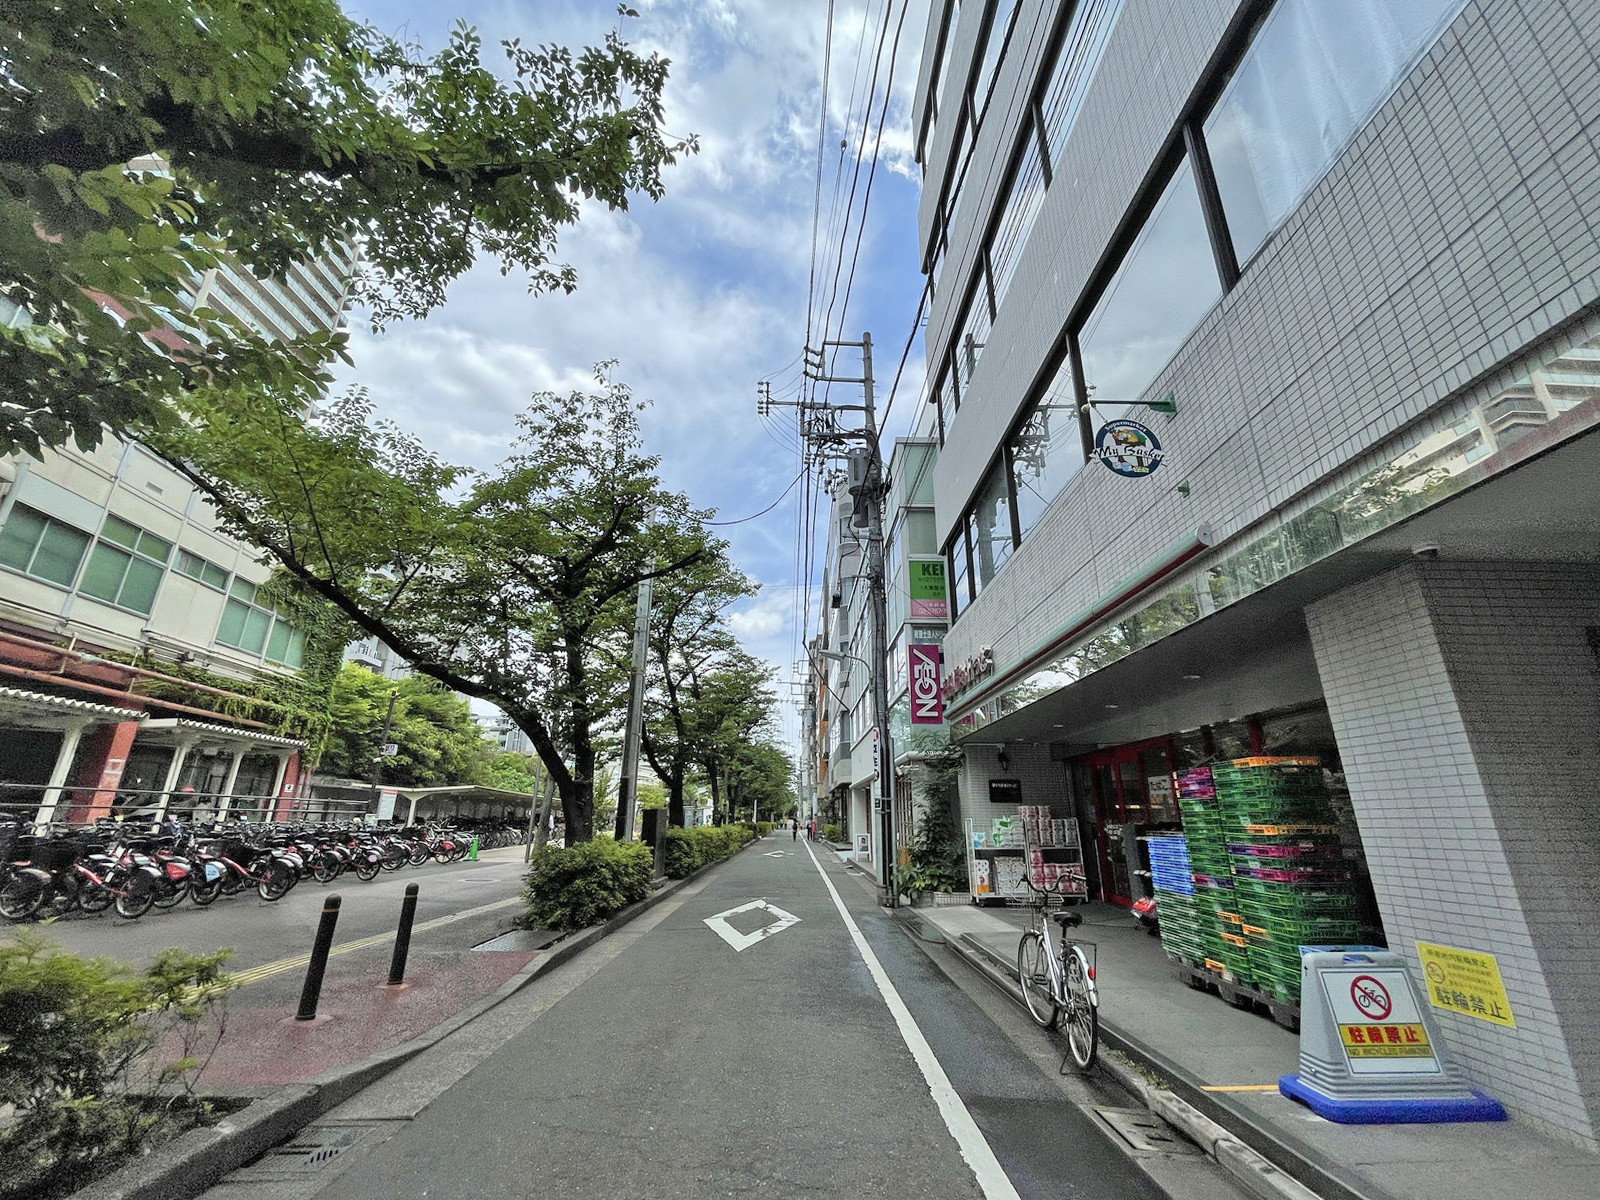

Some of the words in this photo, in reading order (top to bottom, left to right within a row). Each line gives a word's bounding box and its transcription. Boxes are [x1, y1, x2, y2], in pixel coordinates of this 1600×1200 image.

[1105, 421, 1147, 432] Supermarket
[1094, 446, 1118, 458] My
[1124, 446, 1164, 461] Basket
[913, 648, 938, 717] AEON
[1434, 986, 1508, 1020] 駐輪禁止
[1347, 1026, 1421, 1044] 駐輪禁止
[1348, 1048, 1360, 1056] NO
